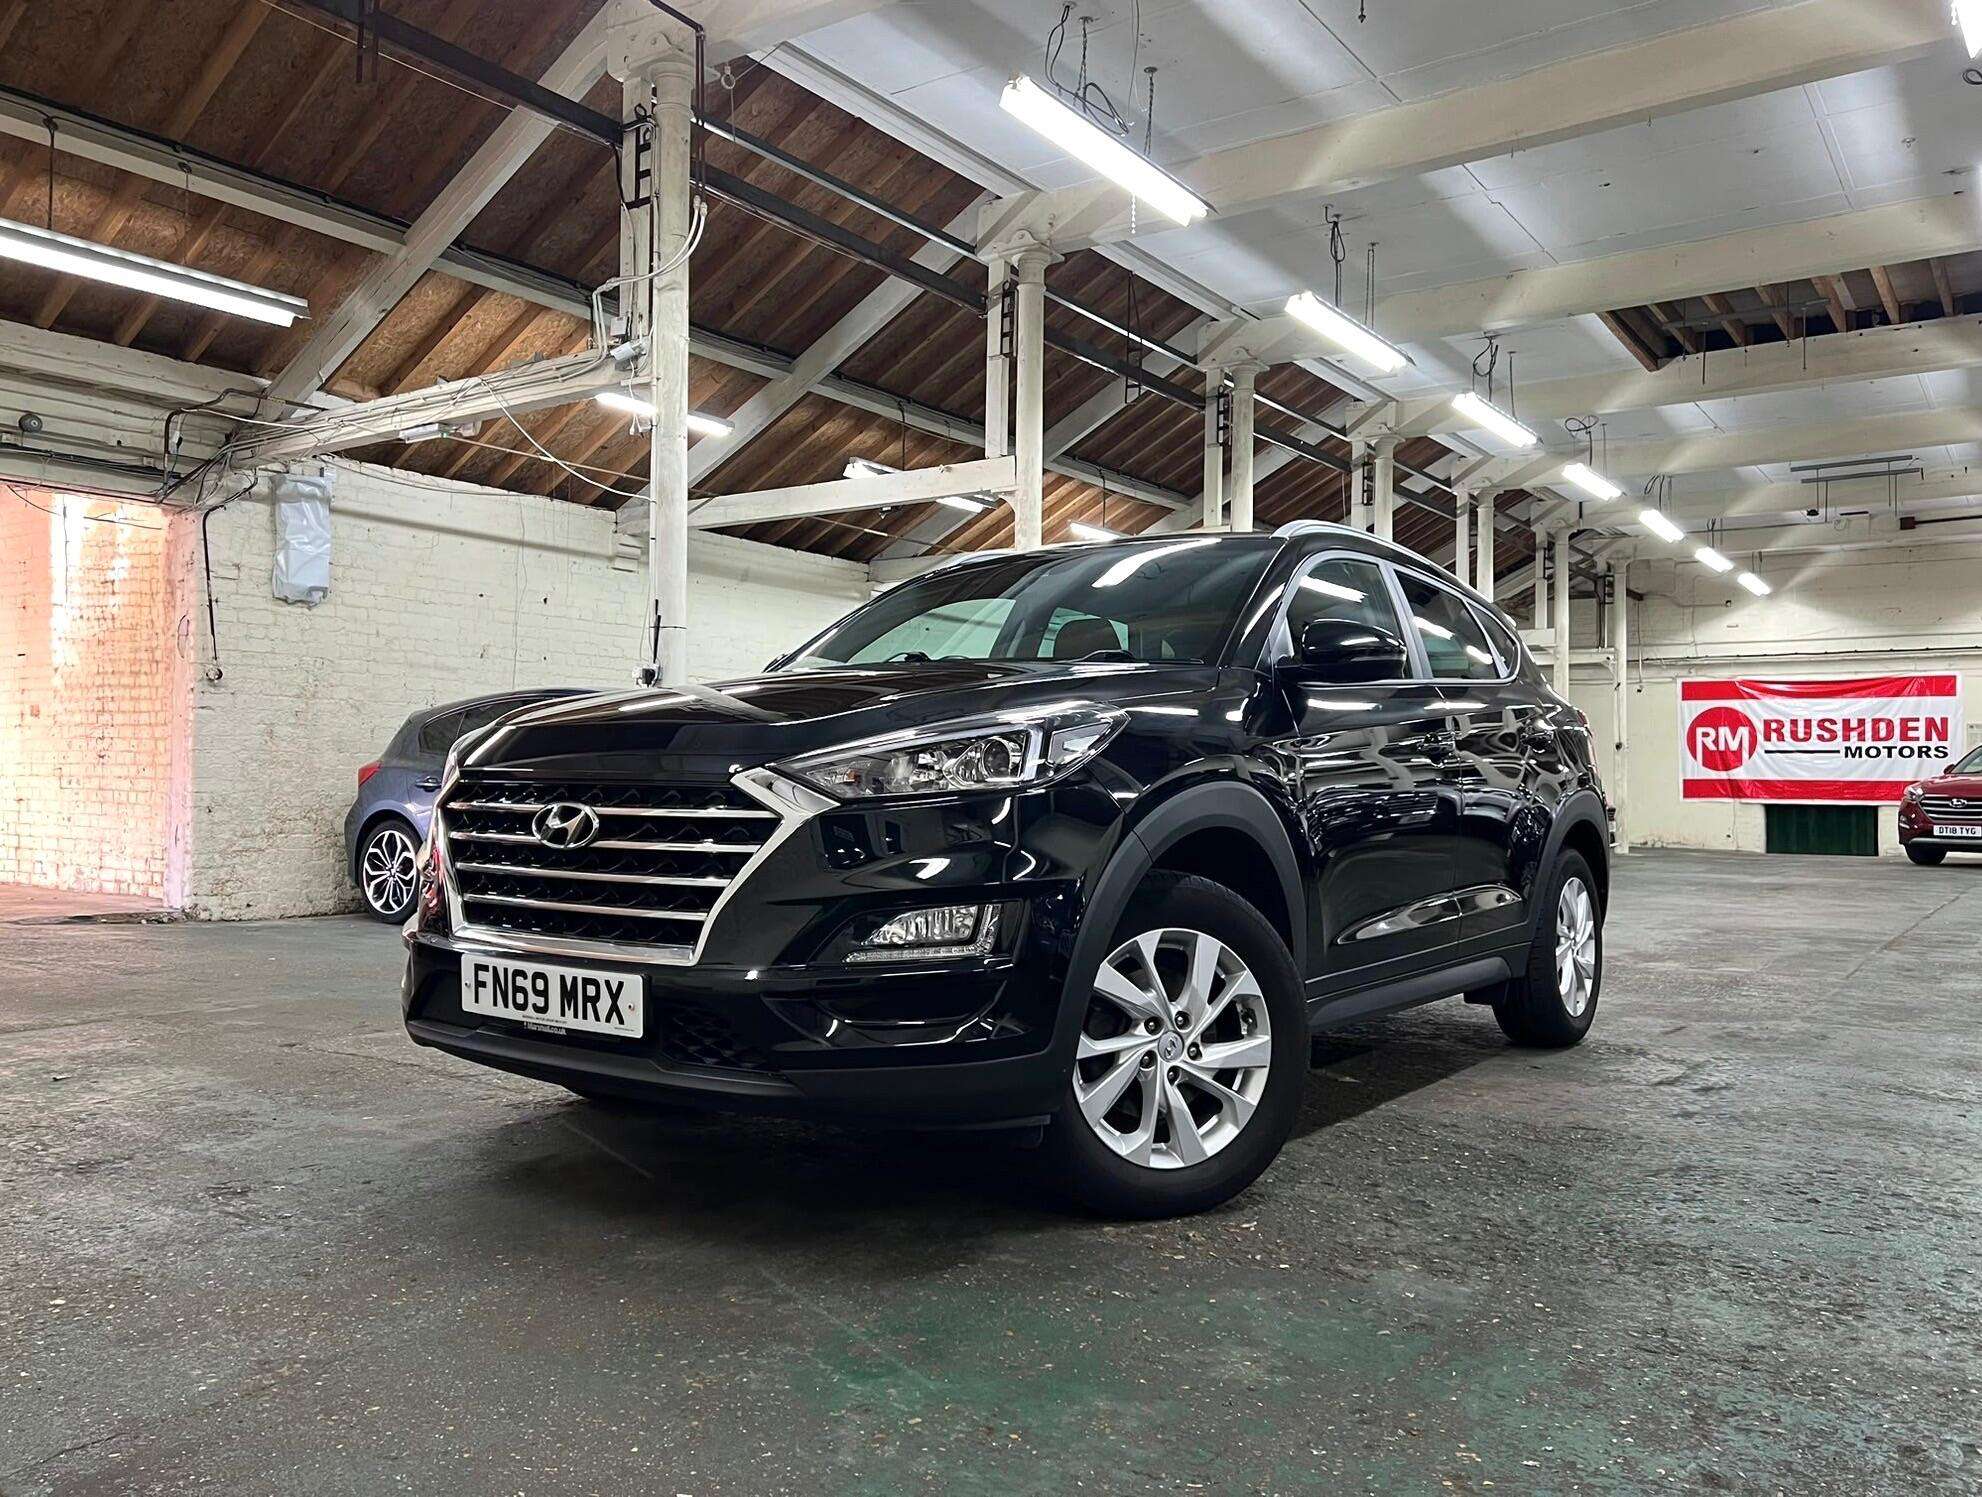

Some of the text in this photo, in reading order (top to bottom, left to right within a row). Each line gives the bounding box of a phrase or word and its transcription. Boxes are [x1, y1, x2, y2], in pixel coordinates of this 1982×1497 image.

[1763, 717, 1949, 742] RUSHDEN
[1696, 726, 1750, 766] RM
[1844, 745, 1949, 759] MOTORS
[1939, 826, 1976, 835] DT18 TYG
[473, 963, 625, 1025] FN69 MRX
